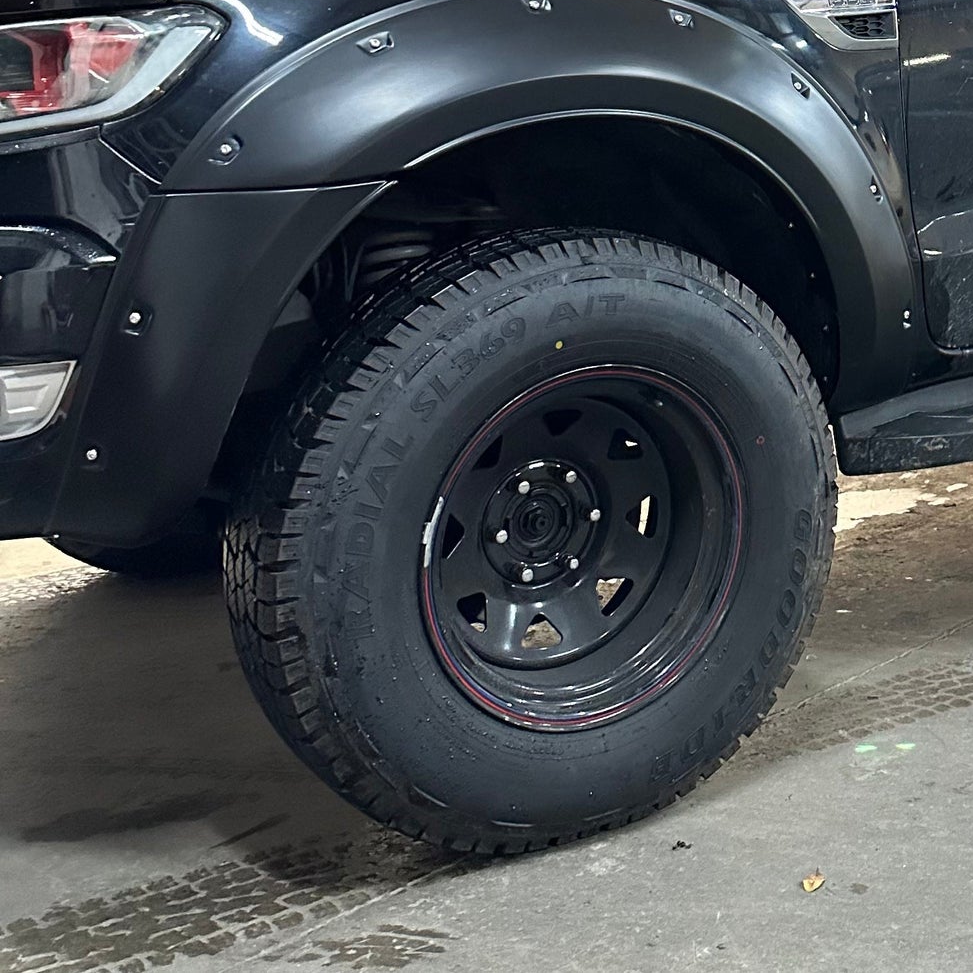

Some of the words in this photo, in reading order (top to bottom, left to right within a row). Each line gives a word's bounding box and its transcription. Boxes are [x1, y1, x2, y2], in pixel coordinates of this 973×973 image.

[341, 435, 415, 642] RADIAL
[409, 315, 527, 424] SL369
[545, 284, 626, 328] A/T
[652, 508, 813, 780] GOODRIDE
